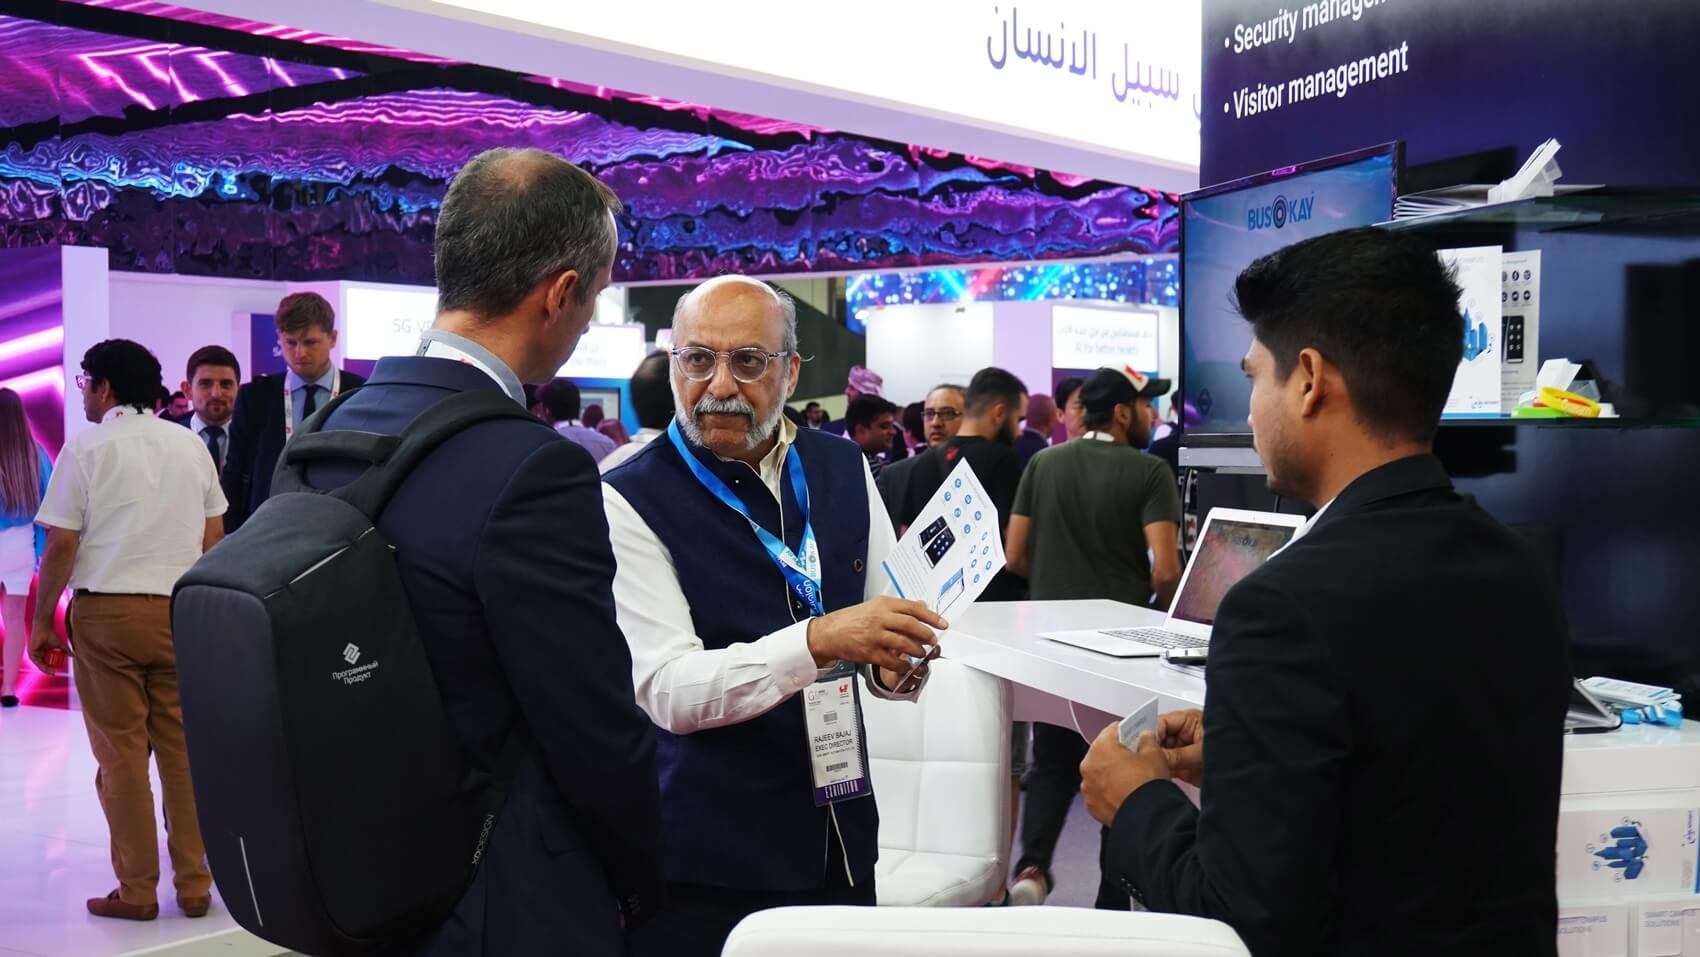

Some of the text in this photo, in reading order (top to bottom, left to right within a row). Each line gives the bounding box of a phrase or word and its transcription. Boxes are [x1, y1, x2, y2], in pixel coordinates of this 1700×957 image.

[1233, 0, 1387, 54] Security manag
[1112, 42, 1179, 108] سبيل
[1233, 84, 1284, 119] Visitor
[1289, 40, 1409, 104] management
[343, 671, 372, 685] Продукт
[814, 733, 835, 743] RAJEEV
